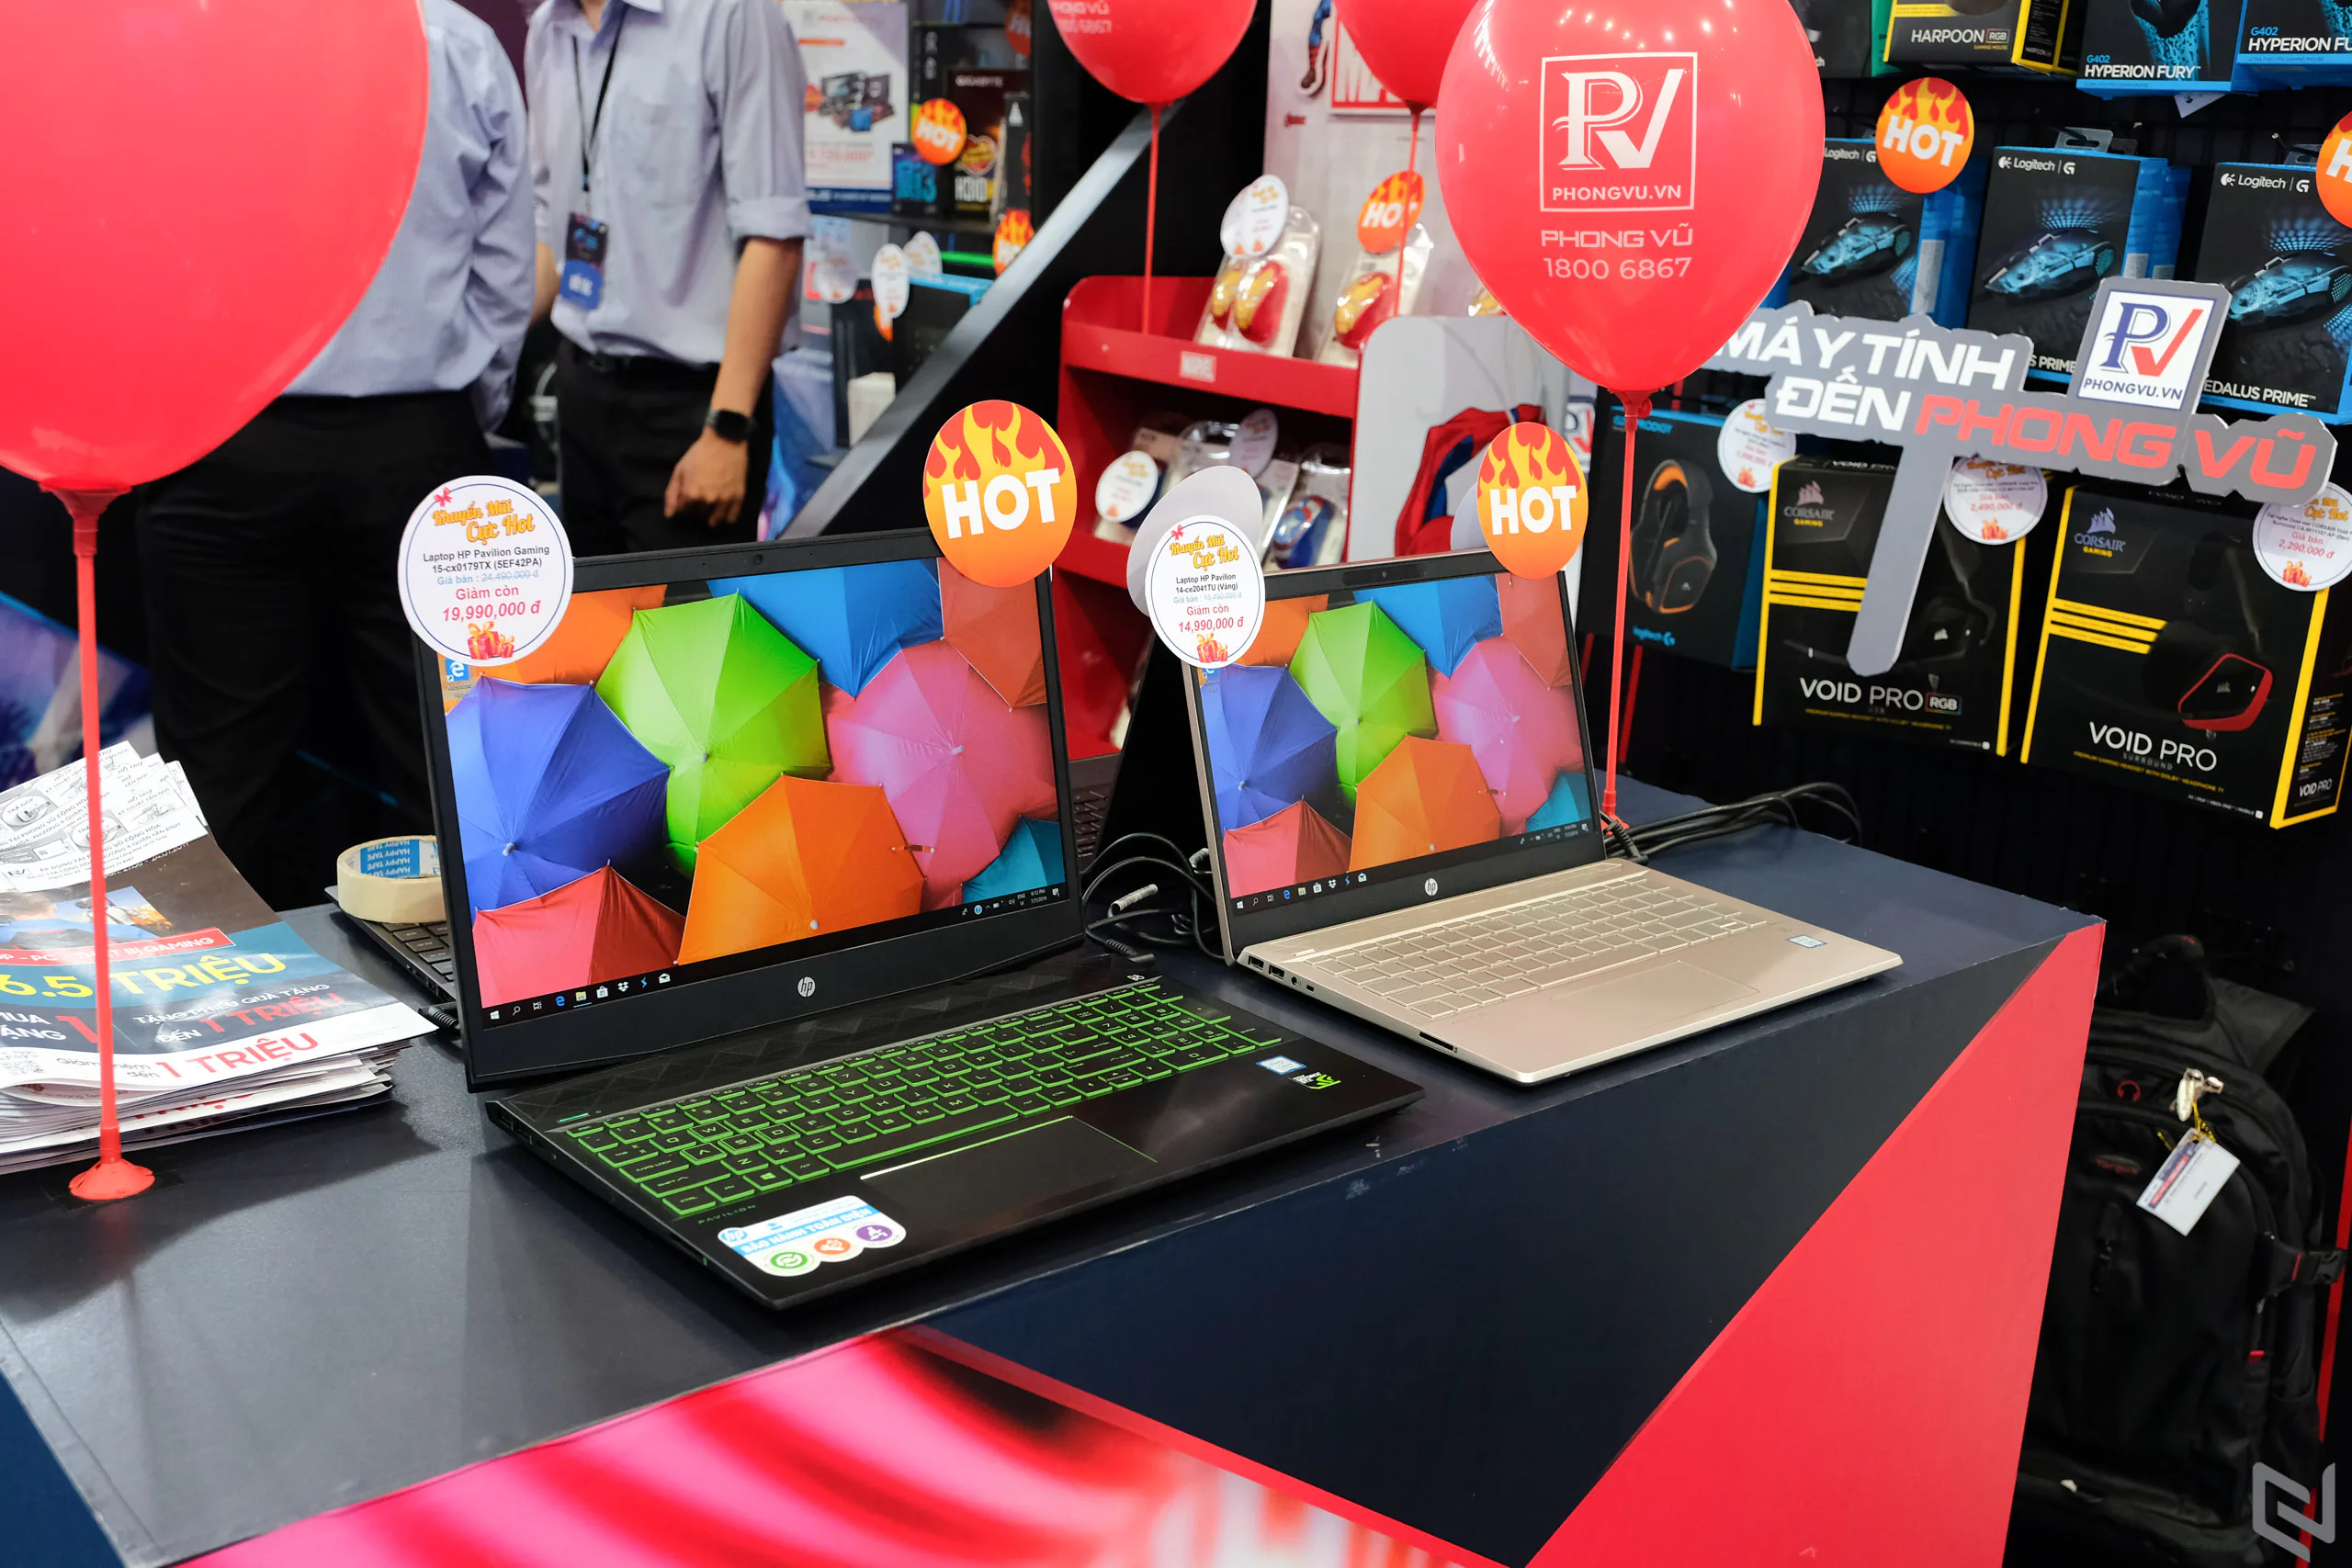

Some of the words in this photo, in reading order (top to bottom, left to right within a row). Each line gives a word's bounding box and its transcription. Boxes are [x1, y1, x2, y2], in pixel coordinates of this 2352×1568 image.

[1911, 28, 1984, 44] HARPOON
[1988, 31, 2007, 41] RGB
[2251, 27, 2278, 37] G402
[2248, 37, 2331, 51] HYPERION
[2086, 55, 2110, 64] G402
[2084, 64, 2156, 79] HYPERION
[917, 118, 961, 152] HOT
[1883, 115, 1964, 167] HOT
[2014, 158, 2055, 173] Logitech
[2238, 175, 2287, 189] Logitech
[1552, 186, 1682, 201] PHONGVU.VN
[1541, 229, 1645, 248] PHONG
[1649, 222, 1693, 247] VŨ
[1543, 257, 1610, 279] 1800
[1619, 256, 1692, 279] 6867
[1861, 315, 2018, 391] TÍNH
[2083, 378, 2183, 401] PHONGVU.VN
[2204, 379, 2260, 400] EDALUS
[1775, 366, 1911, 432] ĐẾN
[1915, 395, 2177, 469] PHONG
[2194, 429, 2317, 491] VŨ
[941, 468, 1060, 539] HOT
[1489, 485, 1577, 535] HOT
[1783, 506, 1836, 521] CORSAIR
[466, 522, 500, 546] Cực
[503, 513, 536, 536] Hot
[2291, 532, 2306, 540] Giá
[2074, 532, 2126, 552] CORSAIR
[2278, 539, 2325, 557] 2,290,000
[423, 552, 455, 562] Laptop
[458, 550, 471, 559] HP
[473, 547, 512, 558] Pavilion
[514, 545, 550, 556] Gaming
[1193, 551, 1216, 571] Cực
[1216, 546, 1240, 563] Hot
[432, 560, 492, 573] 15-cx0179TX
[493, 558, 542, 570] (5EF42PA)
[1176, 577, 1199, 585] Laptop
[1211, 573, 1237, 581] Pavilion
[494, 585, 519, 597] còn
[442, 602, 526, 623] 19,990,000
[530, 600, 541, 614] đ
[1178, 618, 1234, 634] 14,990,000
[1799, 677, 1861, 703] VOID
[1869, 685, 1924, 710] PRO
[1929, 696, 1958, 710] RGB
[2089, 721, 2153, 755] VOID
[2159, 739, 2217, 772] PRO
[2122, 752, 2173, 771] SURROUND
[2299, 781, 2317, 797] VOID
[368, 852, 384, 862] TAPE
[385, 849, 410, 858] HAPPY
[385, 858, 411, 867] HAPPY
[368, 862, 384, 871] TAPE
[386, 867, 411, 875] HAPPY
[144, 936, 215, 953] GAMING
[109, 953, 287, 995] TRIỆU
[241, 991, 279, 1005] QUÀ
[279, 983, 330, 998] TẶNG
[797, 976, 816, 998] hp
[226, 993, 346, 1026] TRIỆU
[155, 1061, 182, 1078] 1
[185, 1032, 319, 1074] TRIỆU
[697, 1204, 757, 1224] PAVILION
